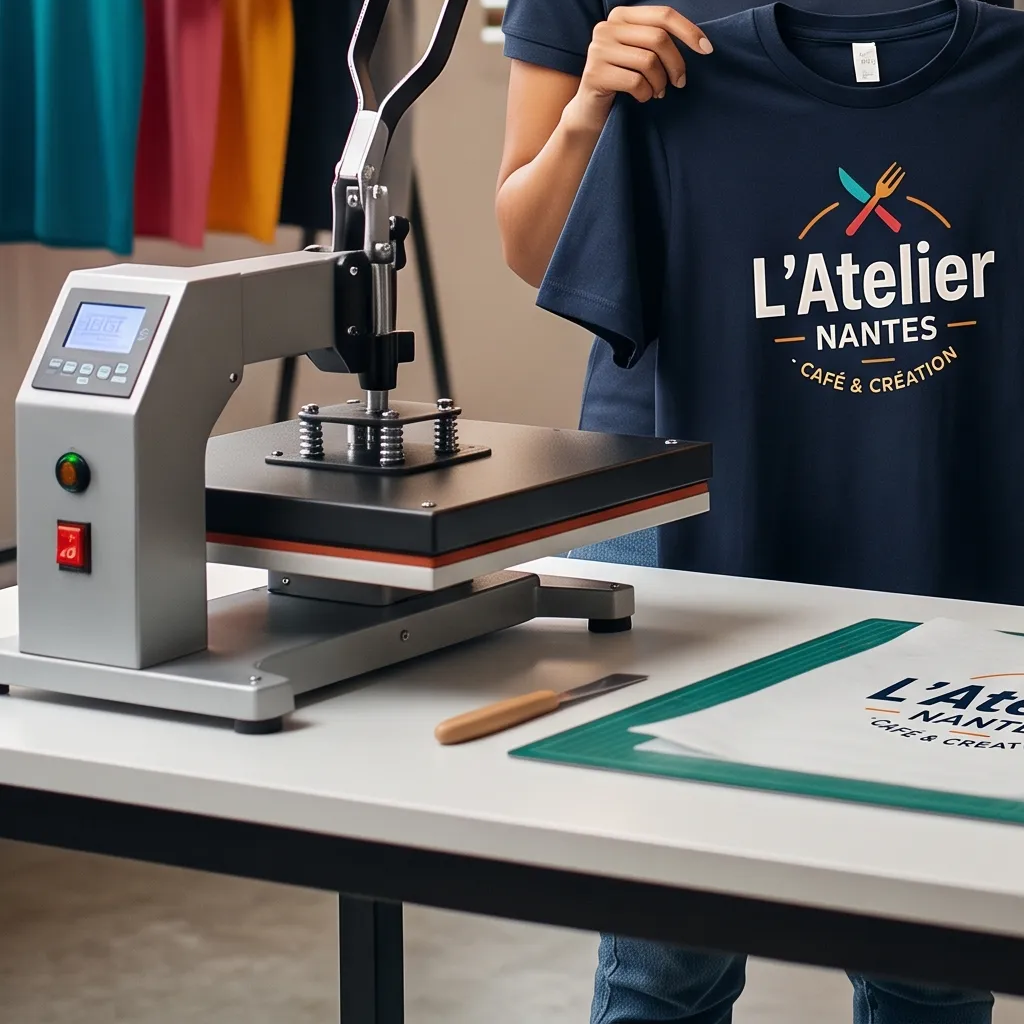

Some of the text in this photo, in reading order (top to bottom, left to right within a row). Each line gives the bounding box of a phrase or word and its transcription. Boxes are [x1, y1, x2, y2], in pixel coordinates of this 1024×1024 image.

[753, 240, 995, 319] L’Atelier
[816, 315, 938, 351] NANTES
[800, 346, 958, 394] CAFÉ & CRÉATION
